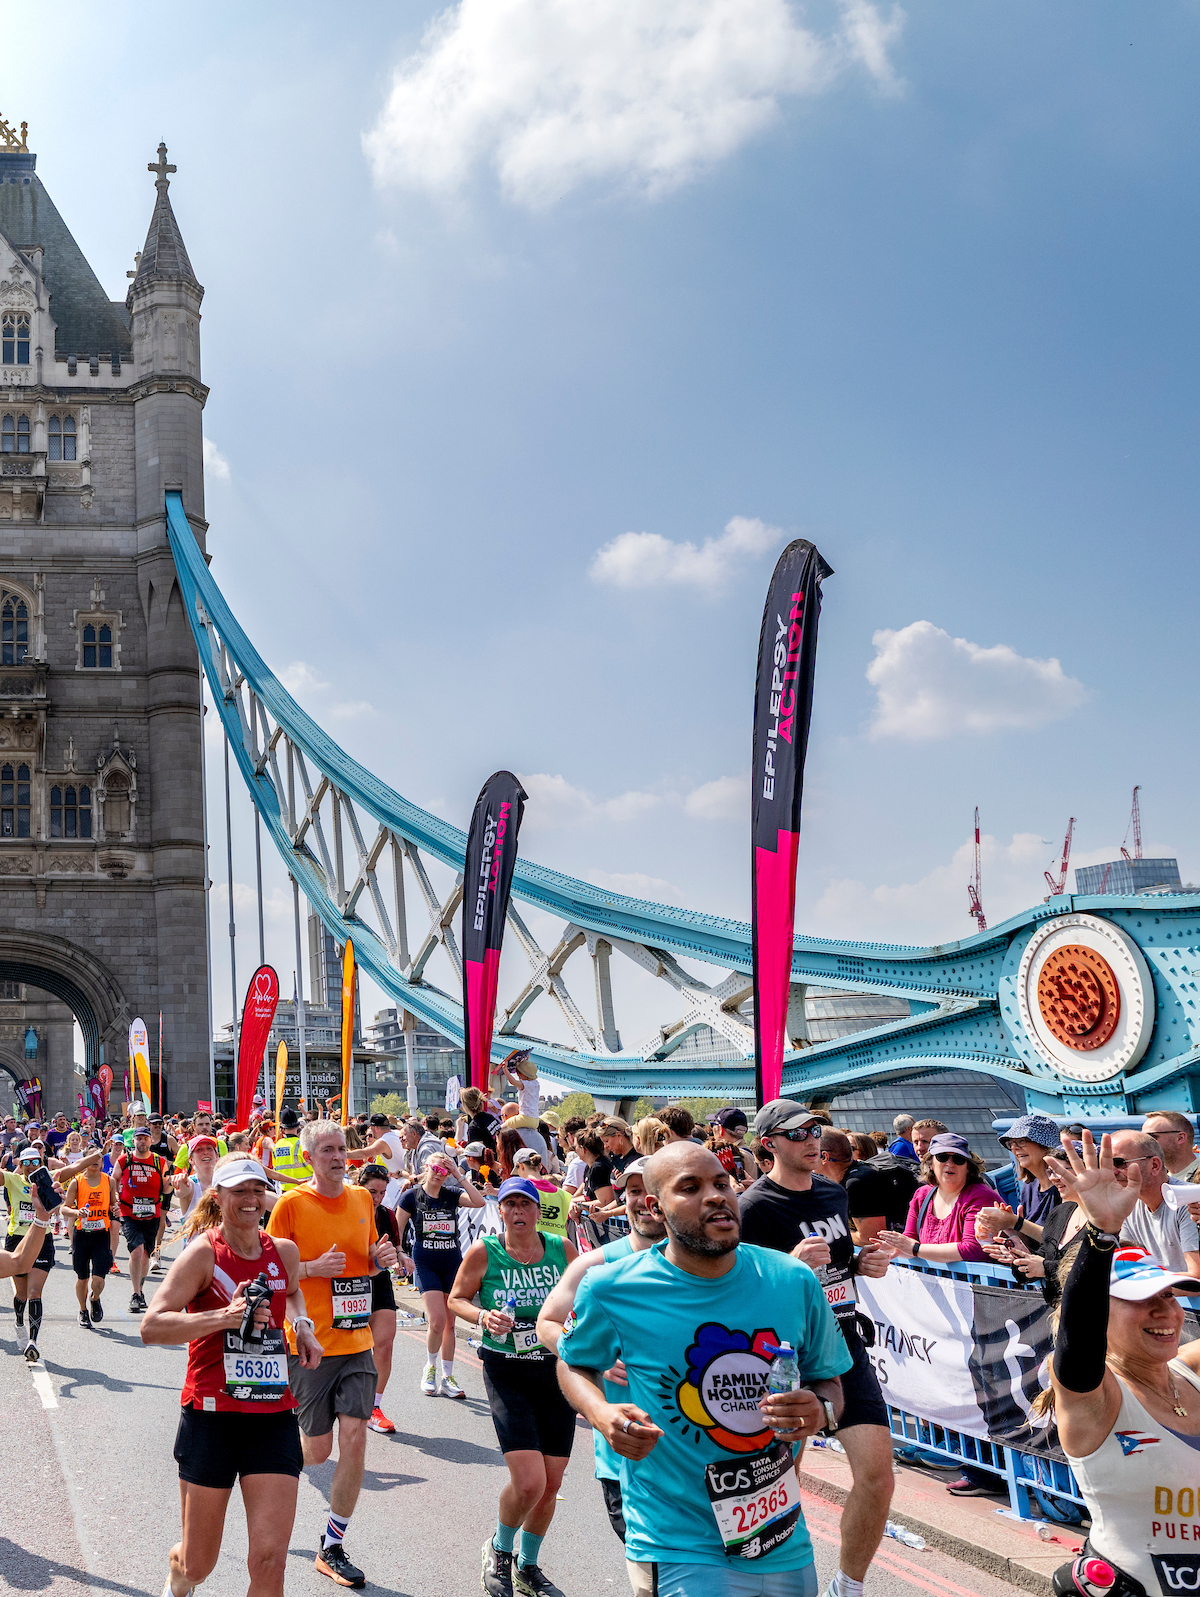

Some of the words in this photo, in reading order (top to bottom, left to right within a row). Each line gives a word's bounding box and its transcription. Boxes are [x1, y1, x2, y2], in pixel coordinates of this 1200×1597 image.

[778, 591, 804, 745] ACTION
[763, 613, 788, 801] EPILEPSY
[474, 813, 498, 931] EPILEPSY
[293, 1086, 330, 1098] Bidge
[88, 1209, 108, 1217] UIDE
[422, 1240, 457, 1249] GEORGIA
[334, 1280, 352, 1293] tcs
[823, 1286, 847, 1305] 802
[341, 1298, 367, 1313] 19932
[495, 1300, 534, 1308] CACER
[505, 1353, 545, 1361] SALOMON
[235, 1360, 280, 1378] 56303
[712, 1372, 769, 1388] FAMILY
[721, 1400, 761, 1413] CHARIT
[749, 1456, 772, 1469] TATA
[752, 1452, 790, 1477] CONSULTANCY
[708, 1468, 751, 1494] tcs
[754, 1469, 781, 1486] SERVICES
[732, 1482, 788, 1533] 22365
[761, 1541, 775, 1552] new
